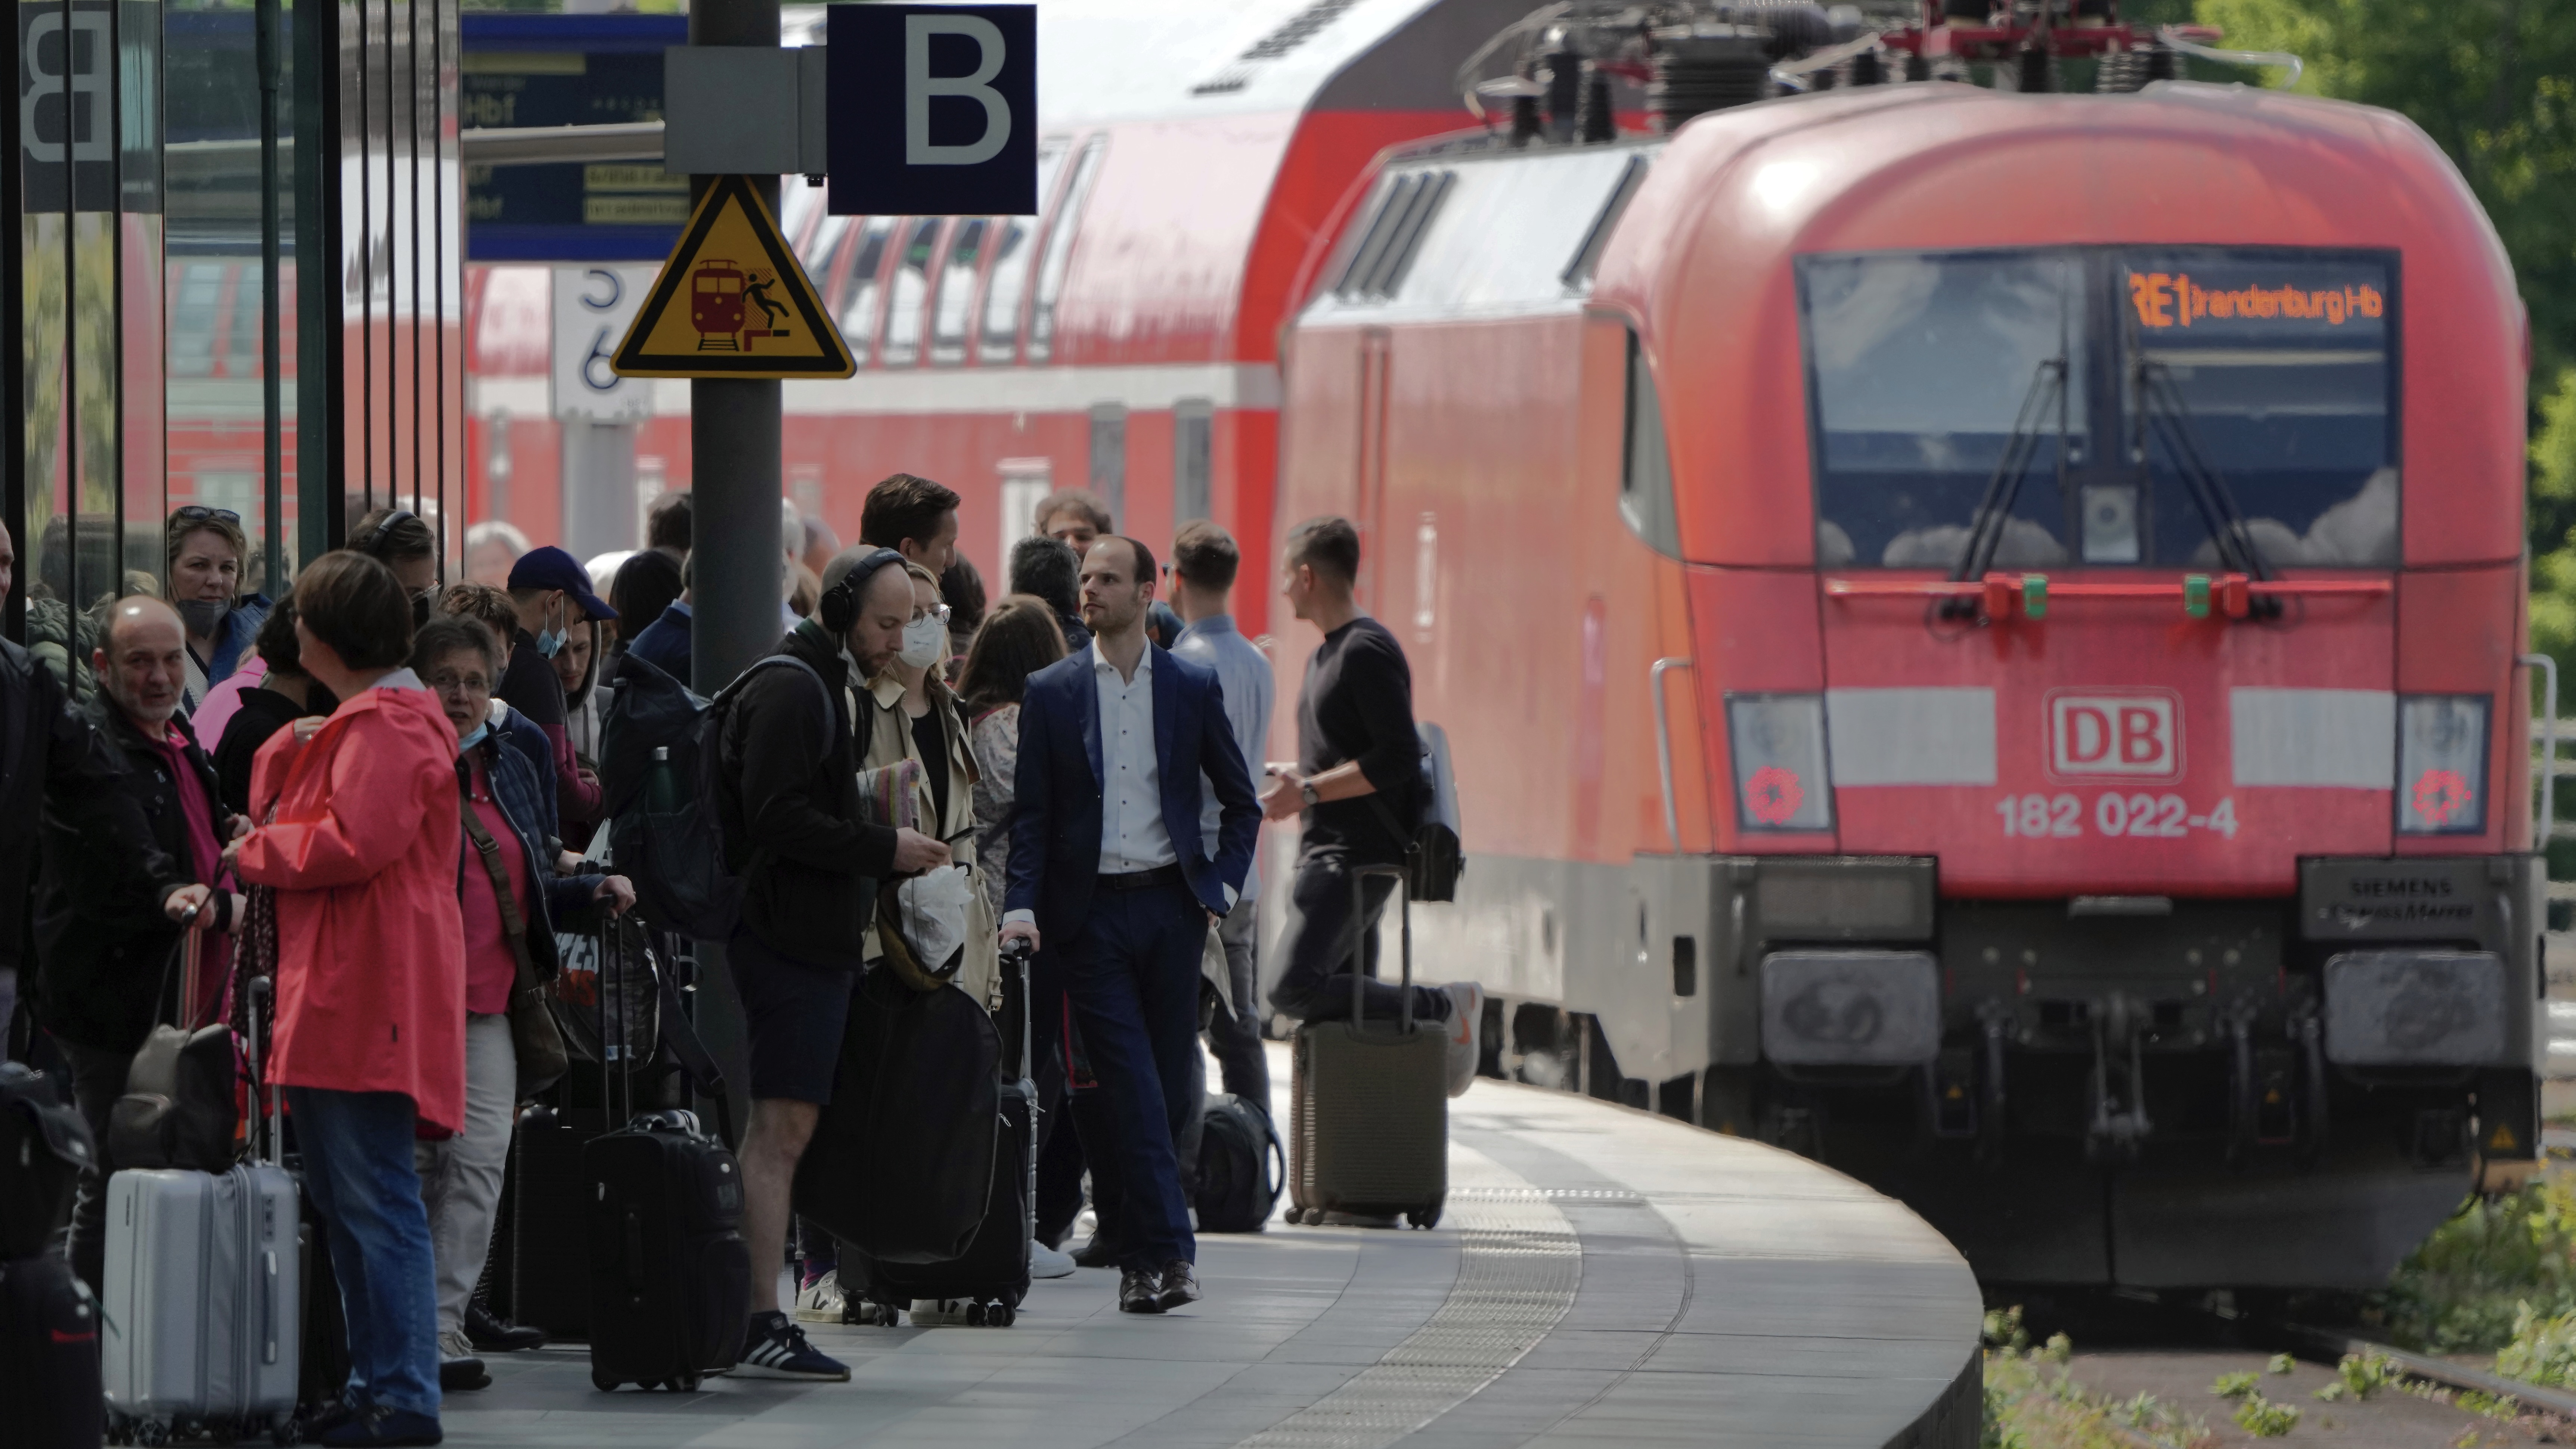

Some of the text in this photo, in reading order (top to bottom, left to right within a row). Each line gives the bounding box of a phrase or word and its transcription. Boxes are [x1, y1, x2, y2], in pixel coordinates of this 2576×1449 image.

[905, 14, 1011, 165] B
[581, 328, 623, 393] 6
[2066, 706, 2165, 764] DB
[1995, 791, 2240, 840] 182 022-4
[2351, 878, 2452, 896] SIEMENS
